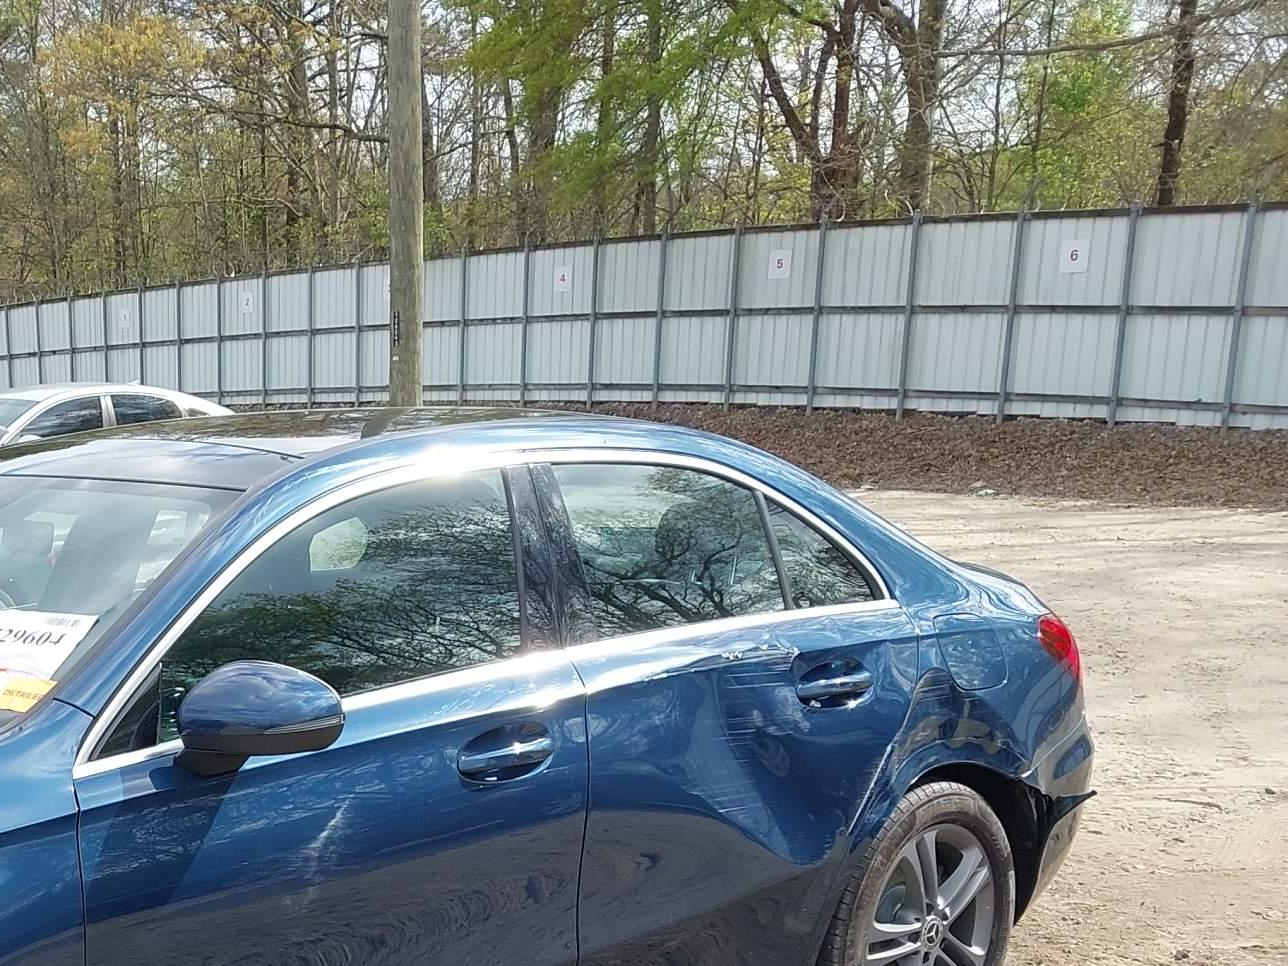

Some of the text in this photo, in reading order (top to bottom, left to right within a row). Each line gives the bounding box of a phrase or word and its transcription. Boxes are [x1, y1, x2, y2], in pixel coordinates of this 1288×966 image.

[1070, 249, 1079, 261] 6
[776, 258, 784, 269] 5
[559, 273, 566, 284] 4
